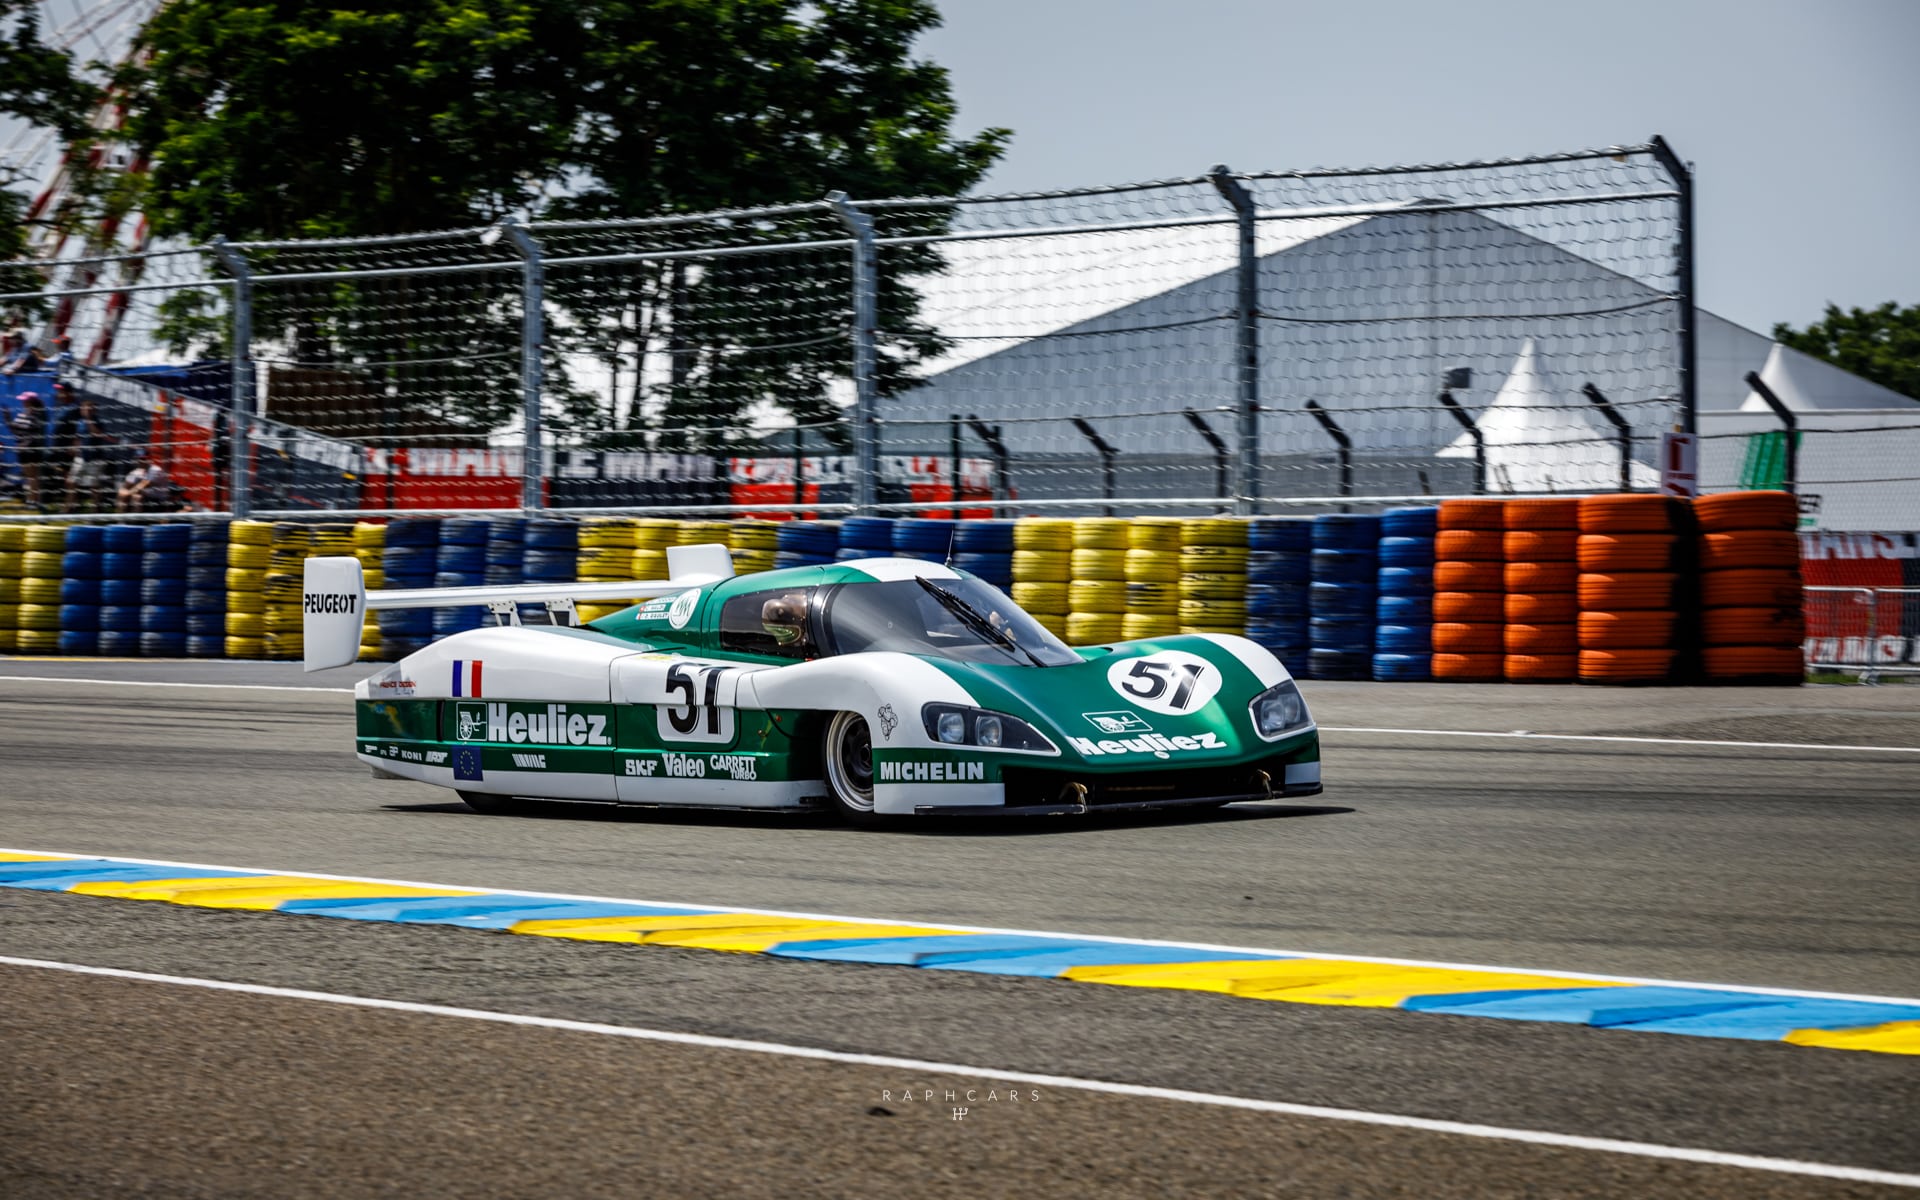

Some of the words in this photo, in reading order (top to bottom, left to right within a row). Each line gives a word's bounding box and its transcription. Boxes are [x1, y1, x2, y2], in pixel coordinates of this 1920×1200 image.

[305, 594, 357, 614] PEUGEOT
[1122, 660, 1204, 710] 51
[665, 662, 733, 735] 51
[401, 750, 422, 760] KONI
[710, 755, 756, 772] GARRETT
[625, 759, 658, 777] SKF
[662, 753, 705, 777] Valeo
[880, 762, 984, 780] MICHELIN
[730, 770, 757, 780] TURBO
